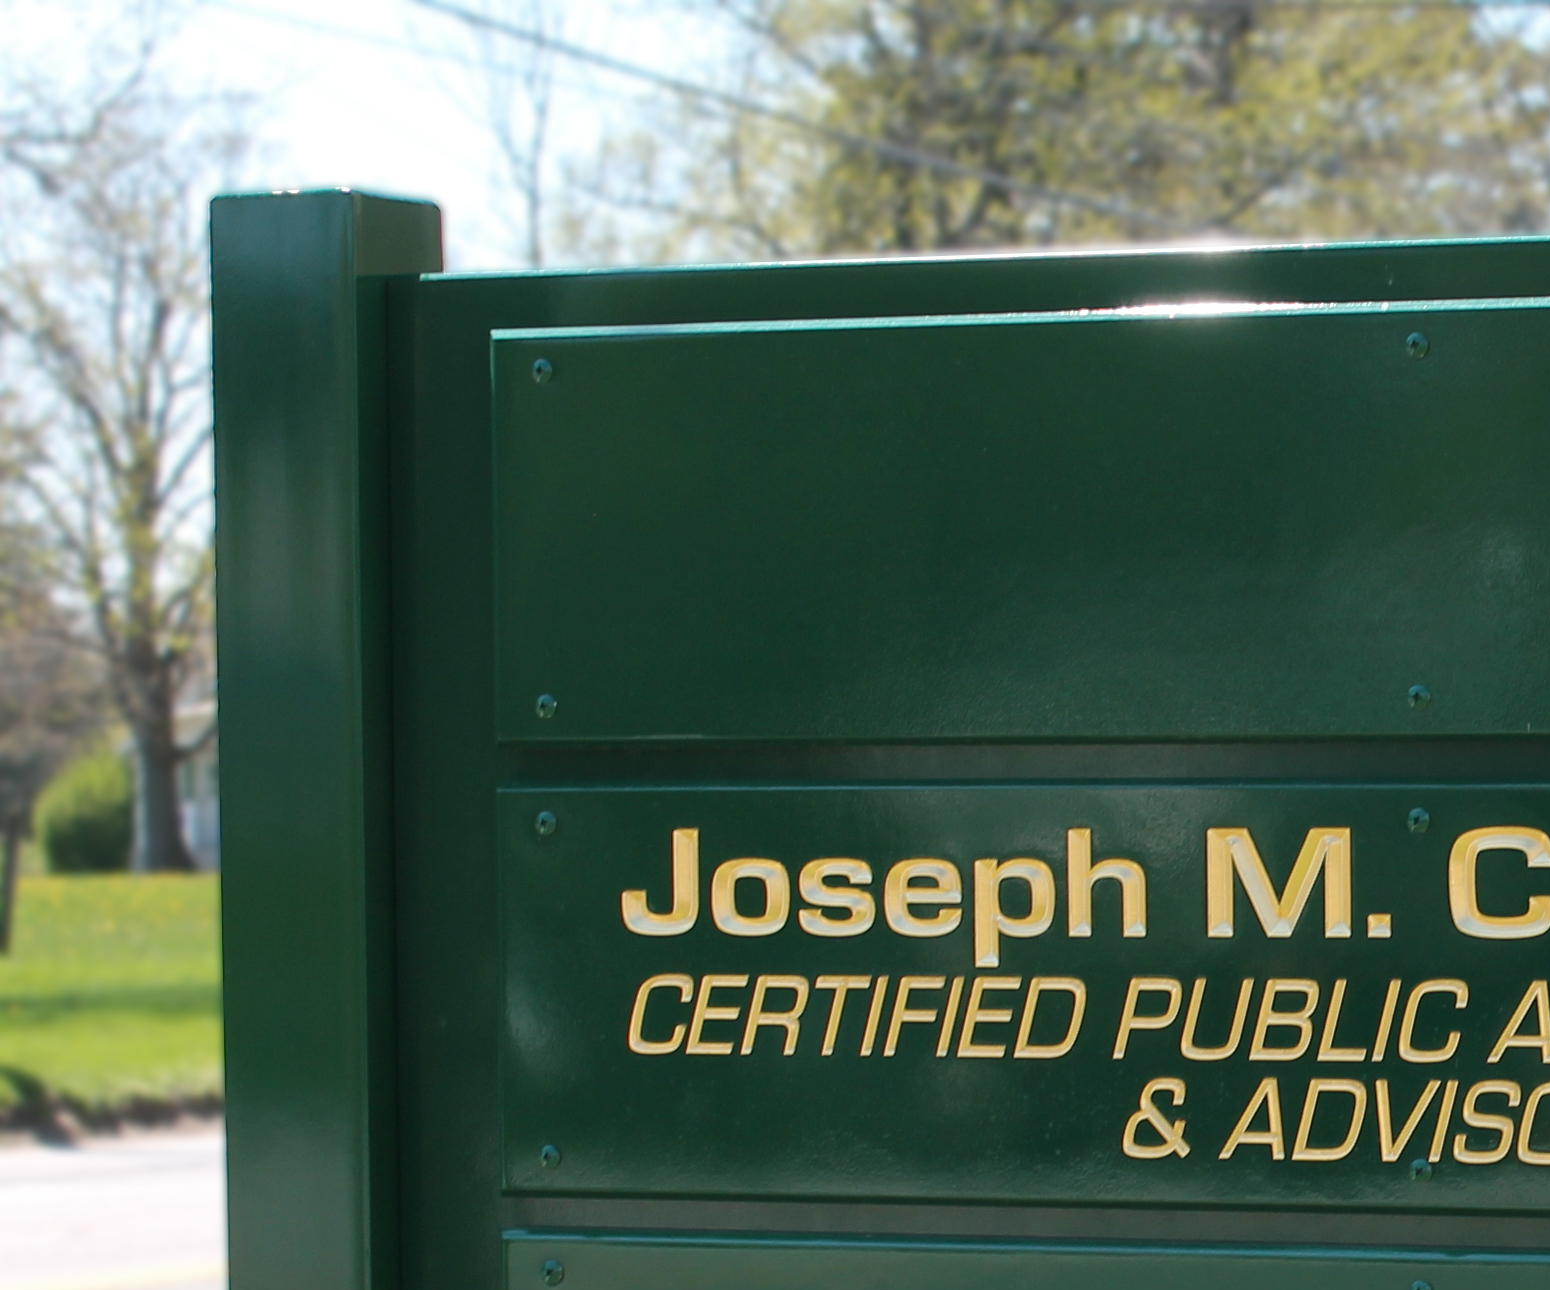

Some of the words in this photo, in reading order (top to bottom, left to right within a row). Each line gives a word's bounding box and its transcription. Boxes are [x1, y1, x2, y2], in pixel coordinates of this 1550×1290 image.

[621, 827, 1147, 968] Joseph
[1206, 827, 1392, 938] M.
[627, 973, 1087, 1059] CERTIFIED
[1113, 977, 1469, 1063] PUBLIC
[1122, 1076, 1191, 1160] &
